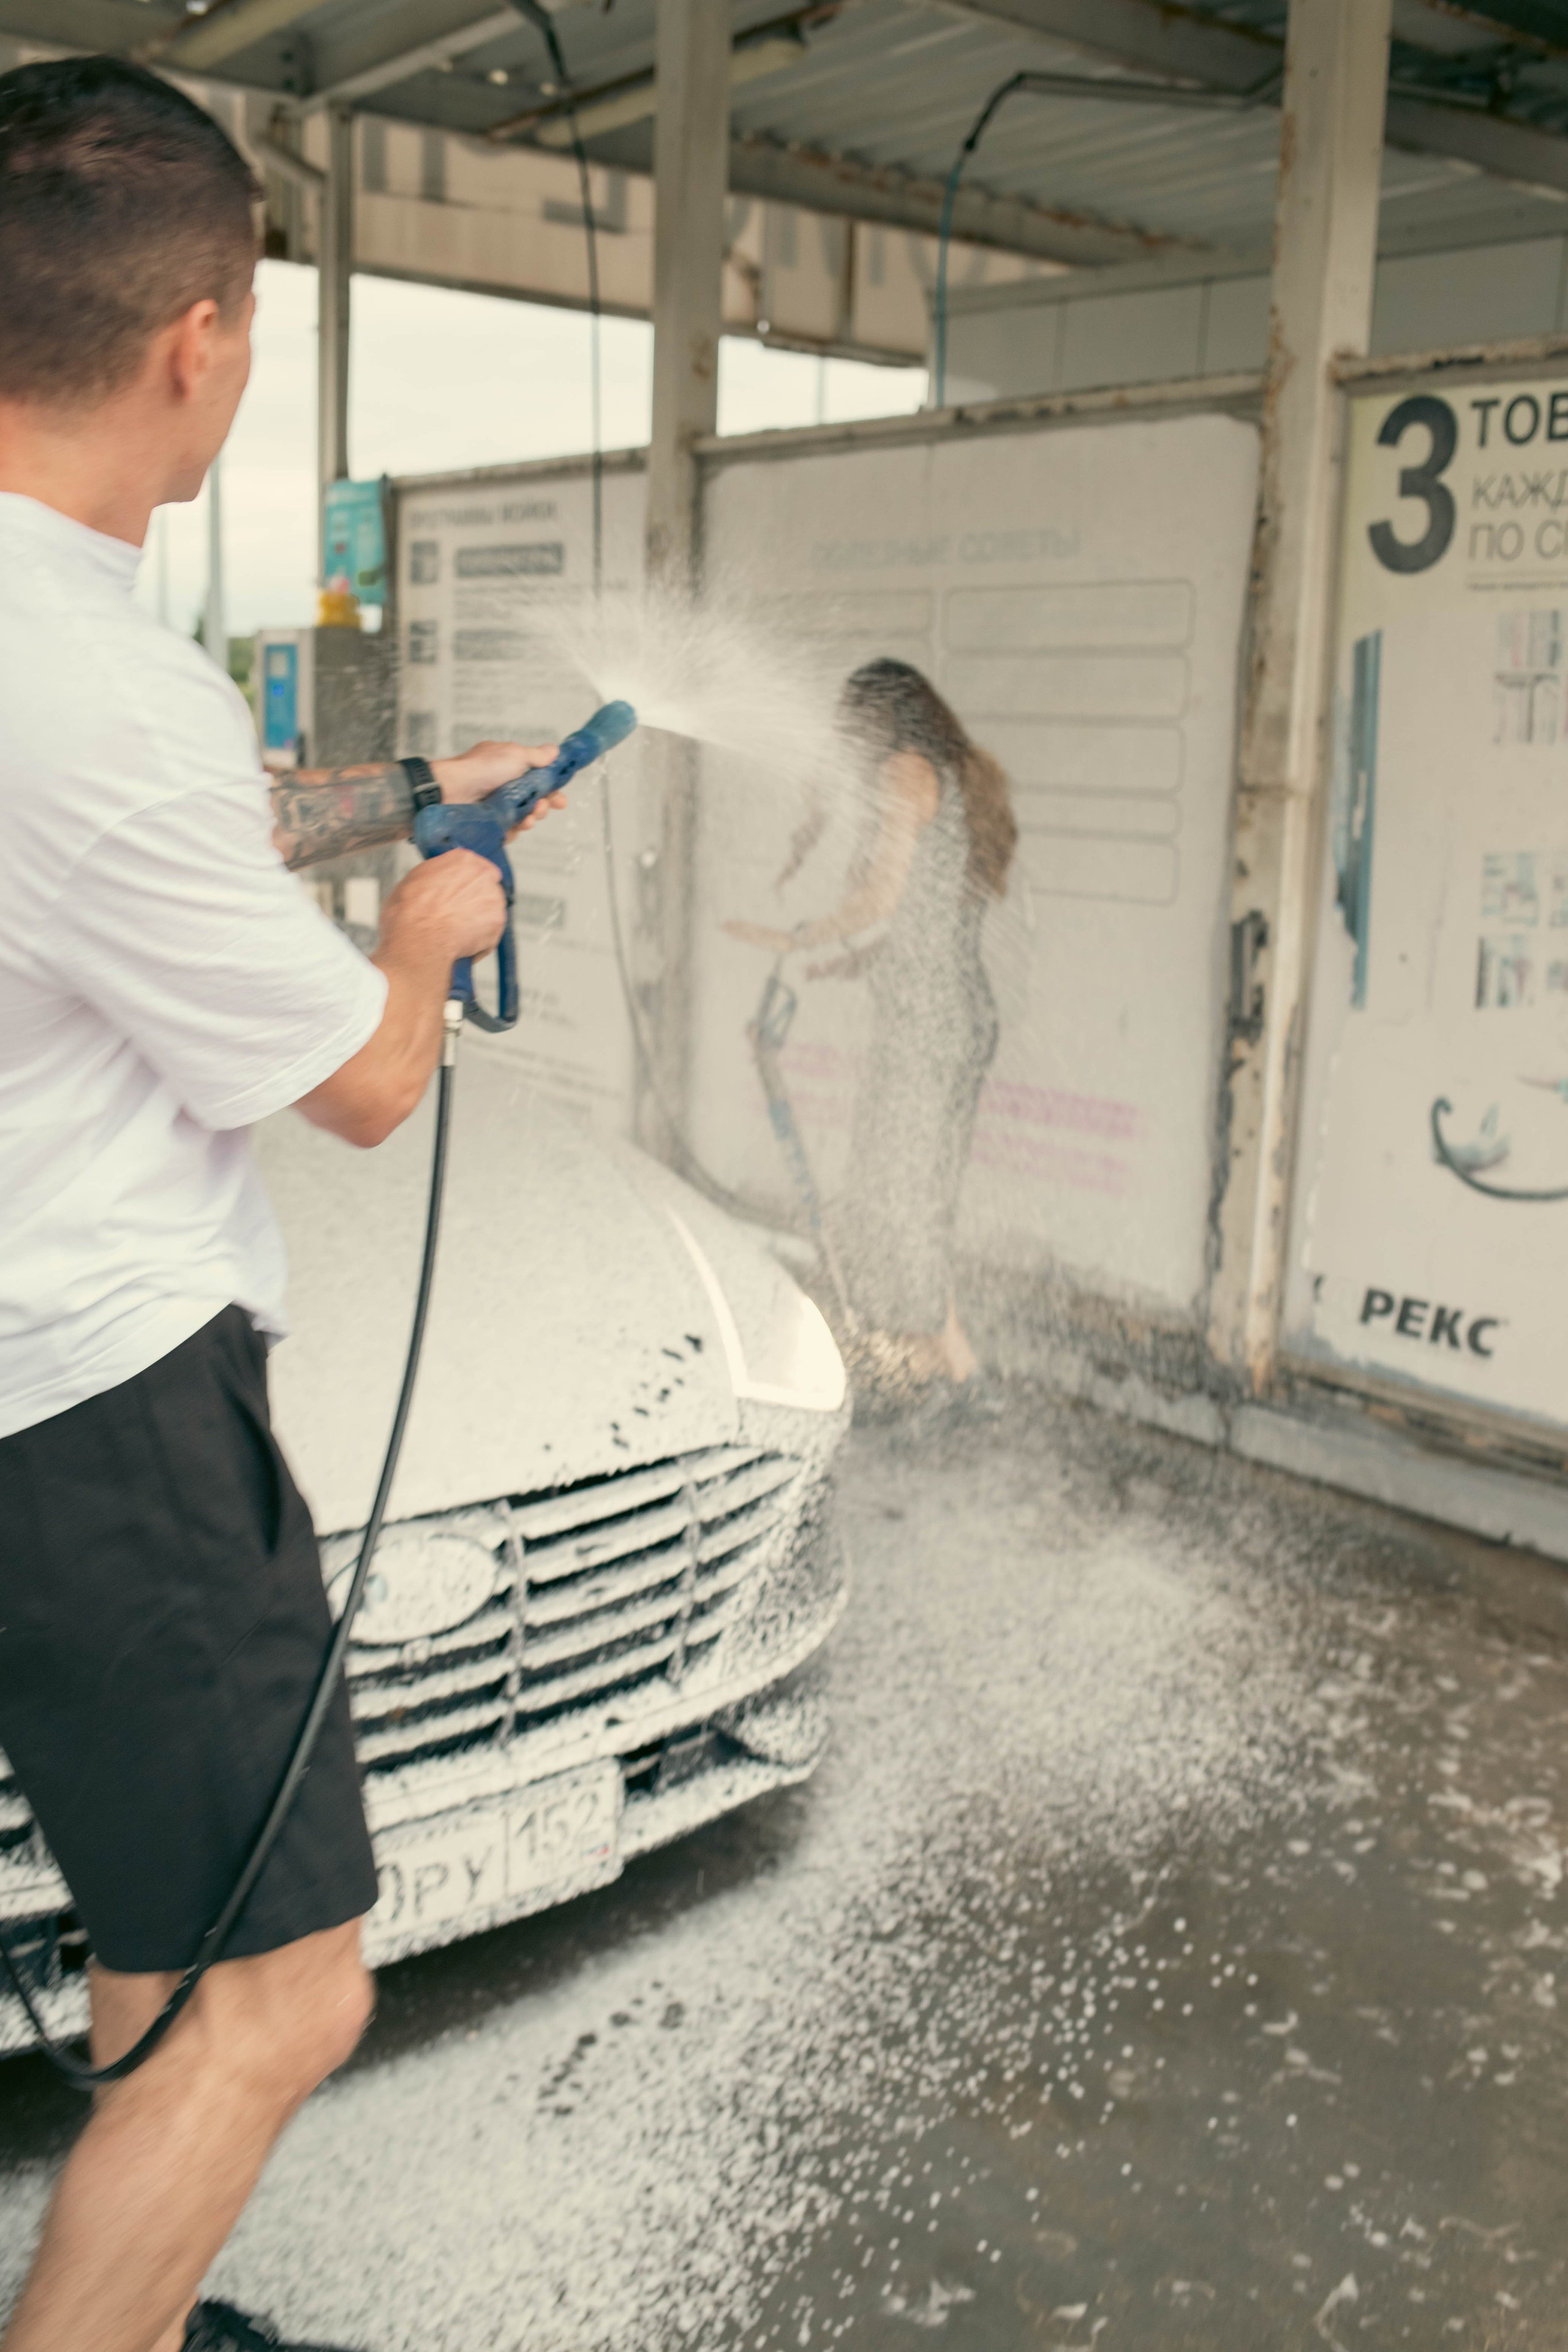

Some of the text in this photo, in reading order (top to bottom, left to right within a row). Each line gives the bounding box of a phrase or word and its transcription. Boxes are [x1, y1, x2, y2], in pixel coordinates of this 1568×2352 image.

[1368, 395, 1459, 575] 3
[1469, 519, 1568, 560] ПО С
[1360, 1287, 1499, 1358] РЕКС
[515, 1791, 603, 1861] 152
